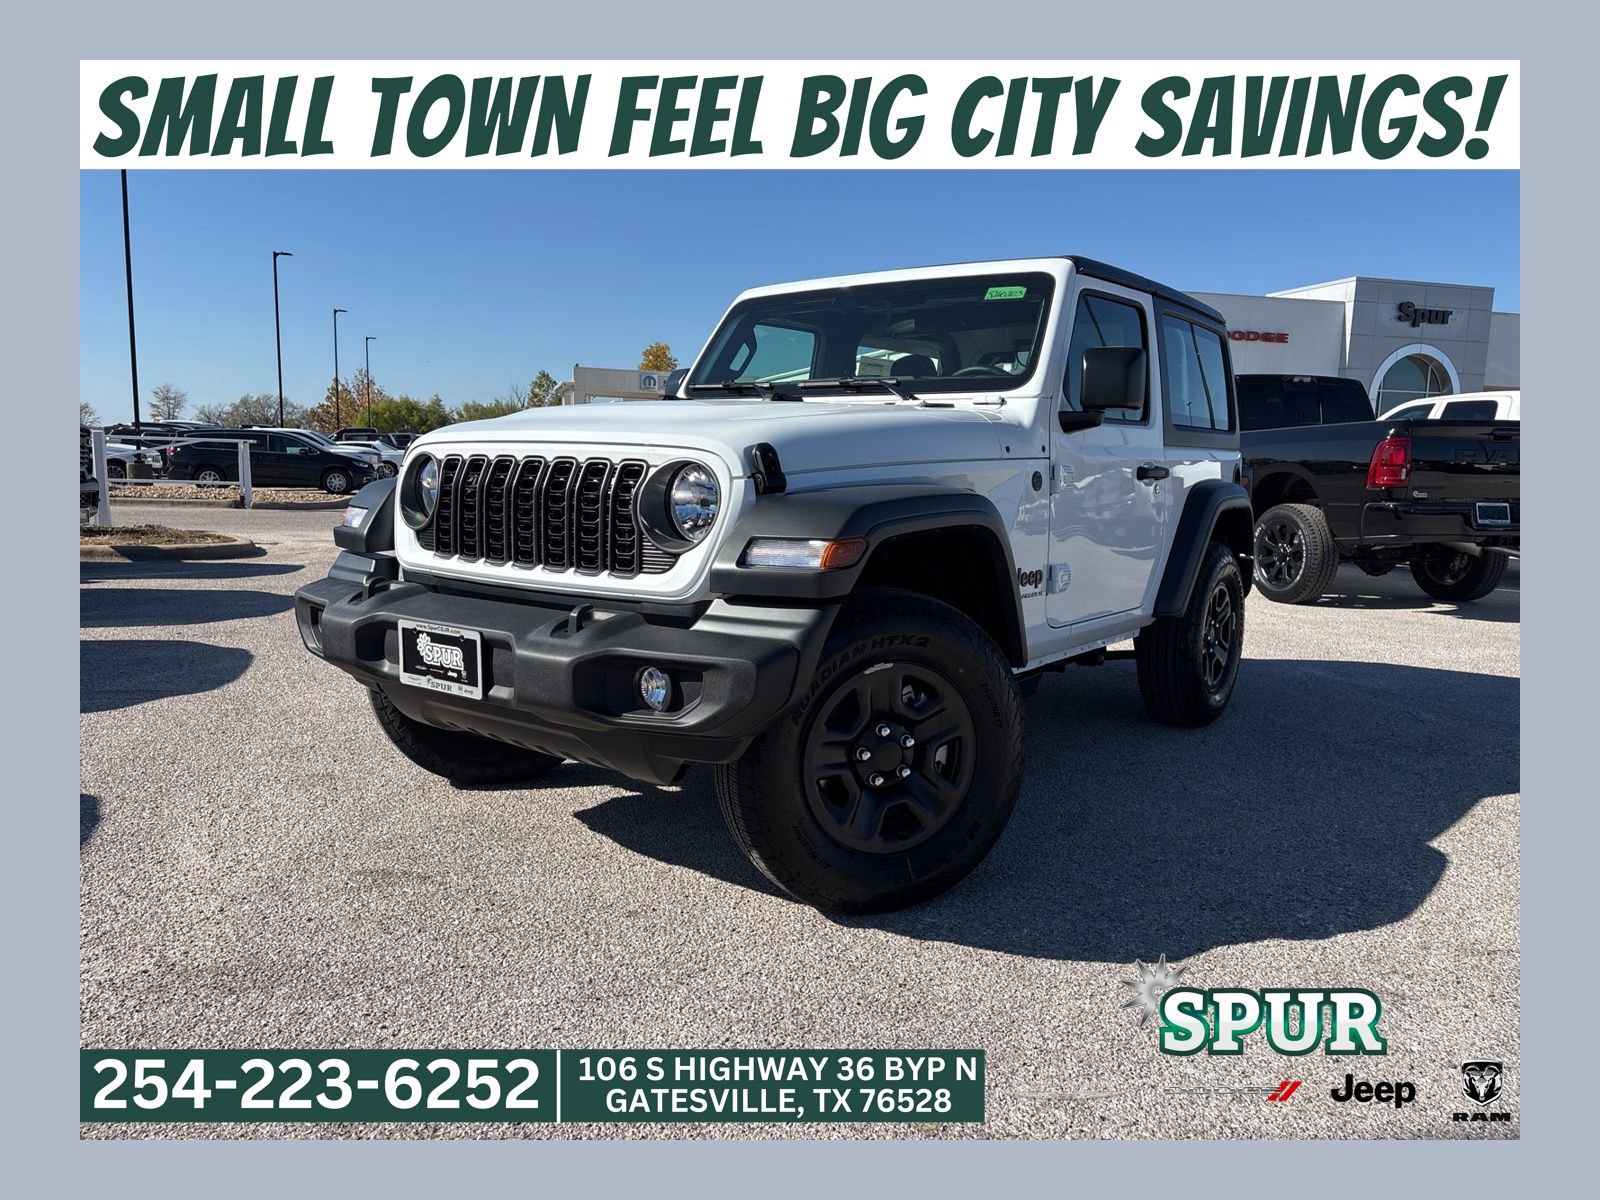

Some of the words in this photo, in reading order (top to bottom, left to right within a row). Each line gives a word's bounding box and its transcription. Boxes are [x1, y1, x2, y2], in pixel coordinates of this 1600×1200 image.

[1398, 301, 1453, 327] Spur
[870, 634, 931, 651] HTX2
[424, 643, 463, 670] SPUR
[430, 681, 453, 692] SPUR
